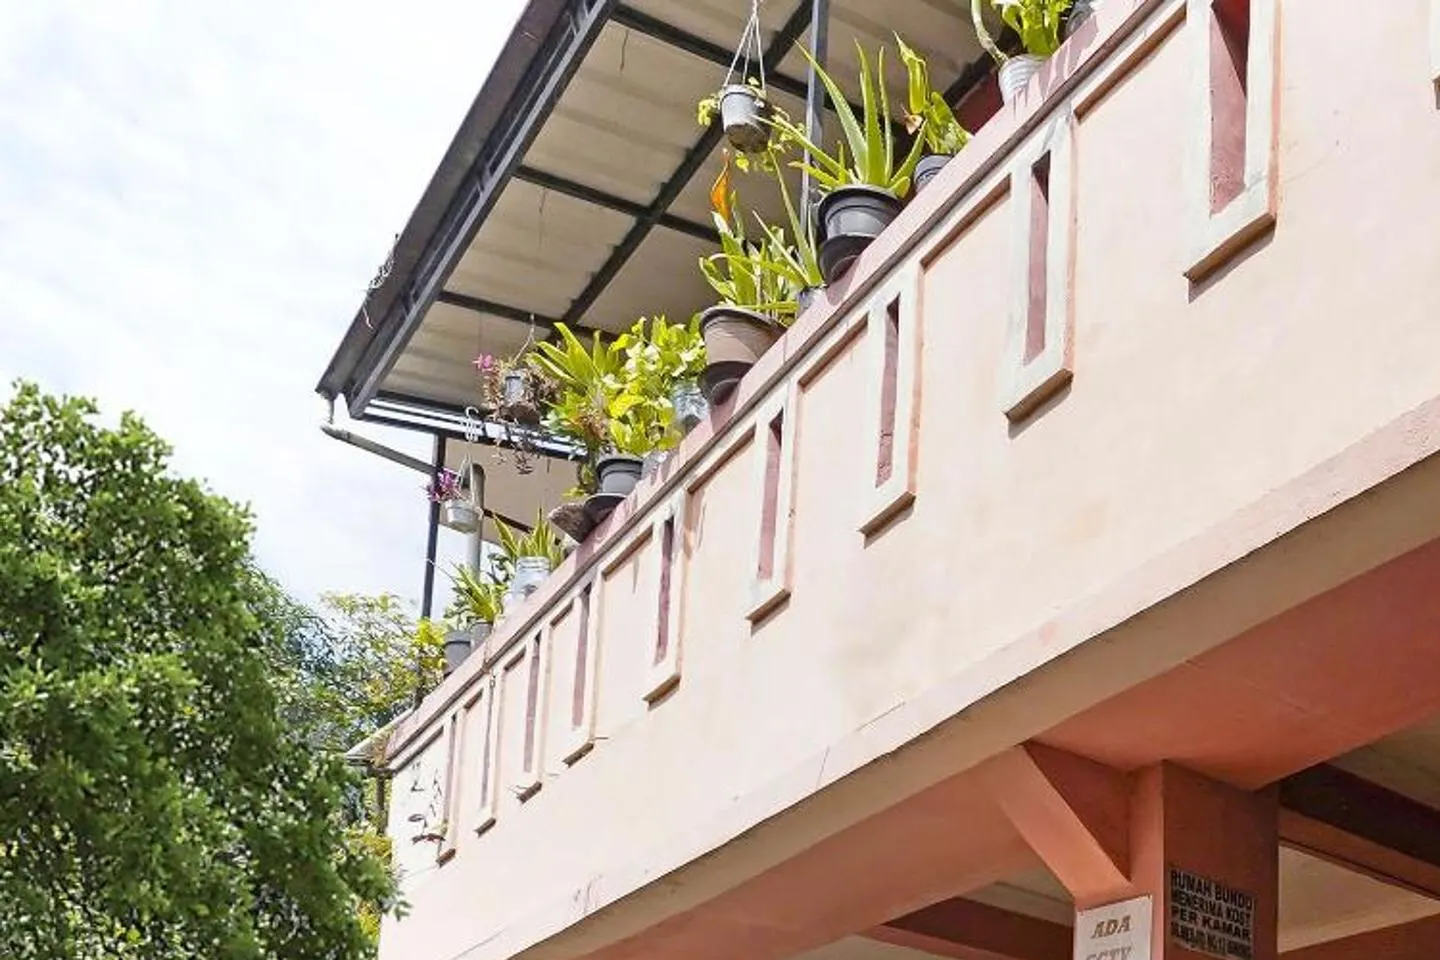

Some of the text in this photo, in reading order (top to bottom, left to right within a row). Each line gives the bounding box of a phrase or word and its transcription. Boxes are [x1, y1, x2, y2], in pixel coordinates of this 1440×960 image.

[1171, 870, 1211, 898] RUMAH
[1091, 915, 1131, 939] ADA
[1171, 905, 1198, 924] PER
[1201, 916, 1251, 942] KAMAR
